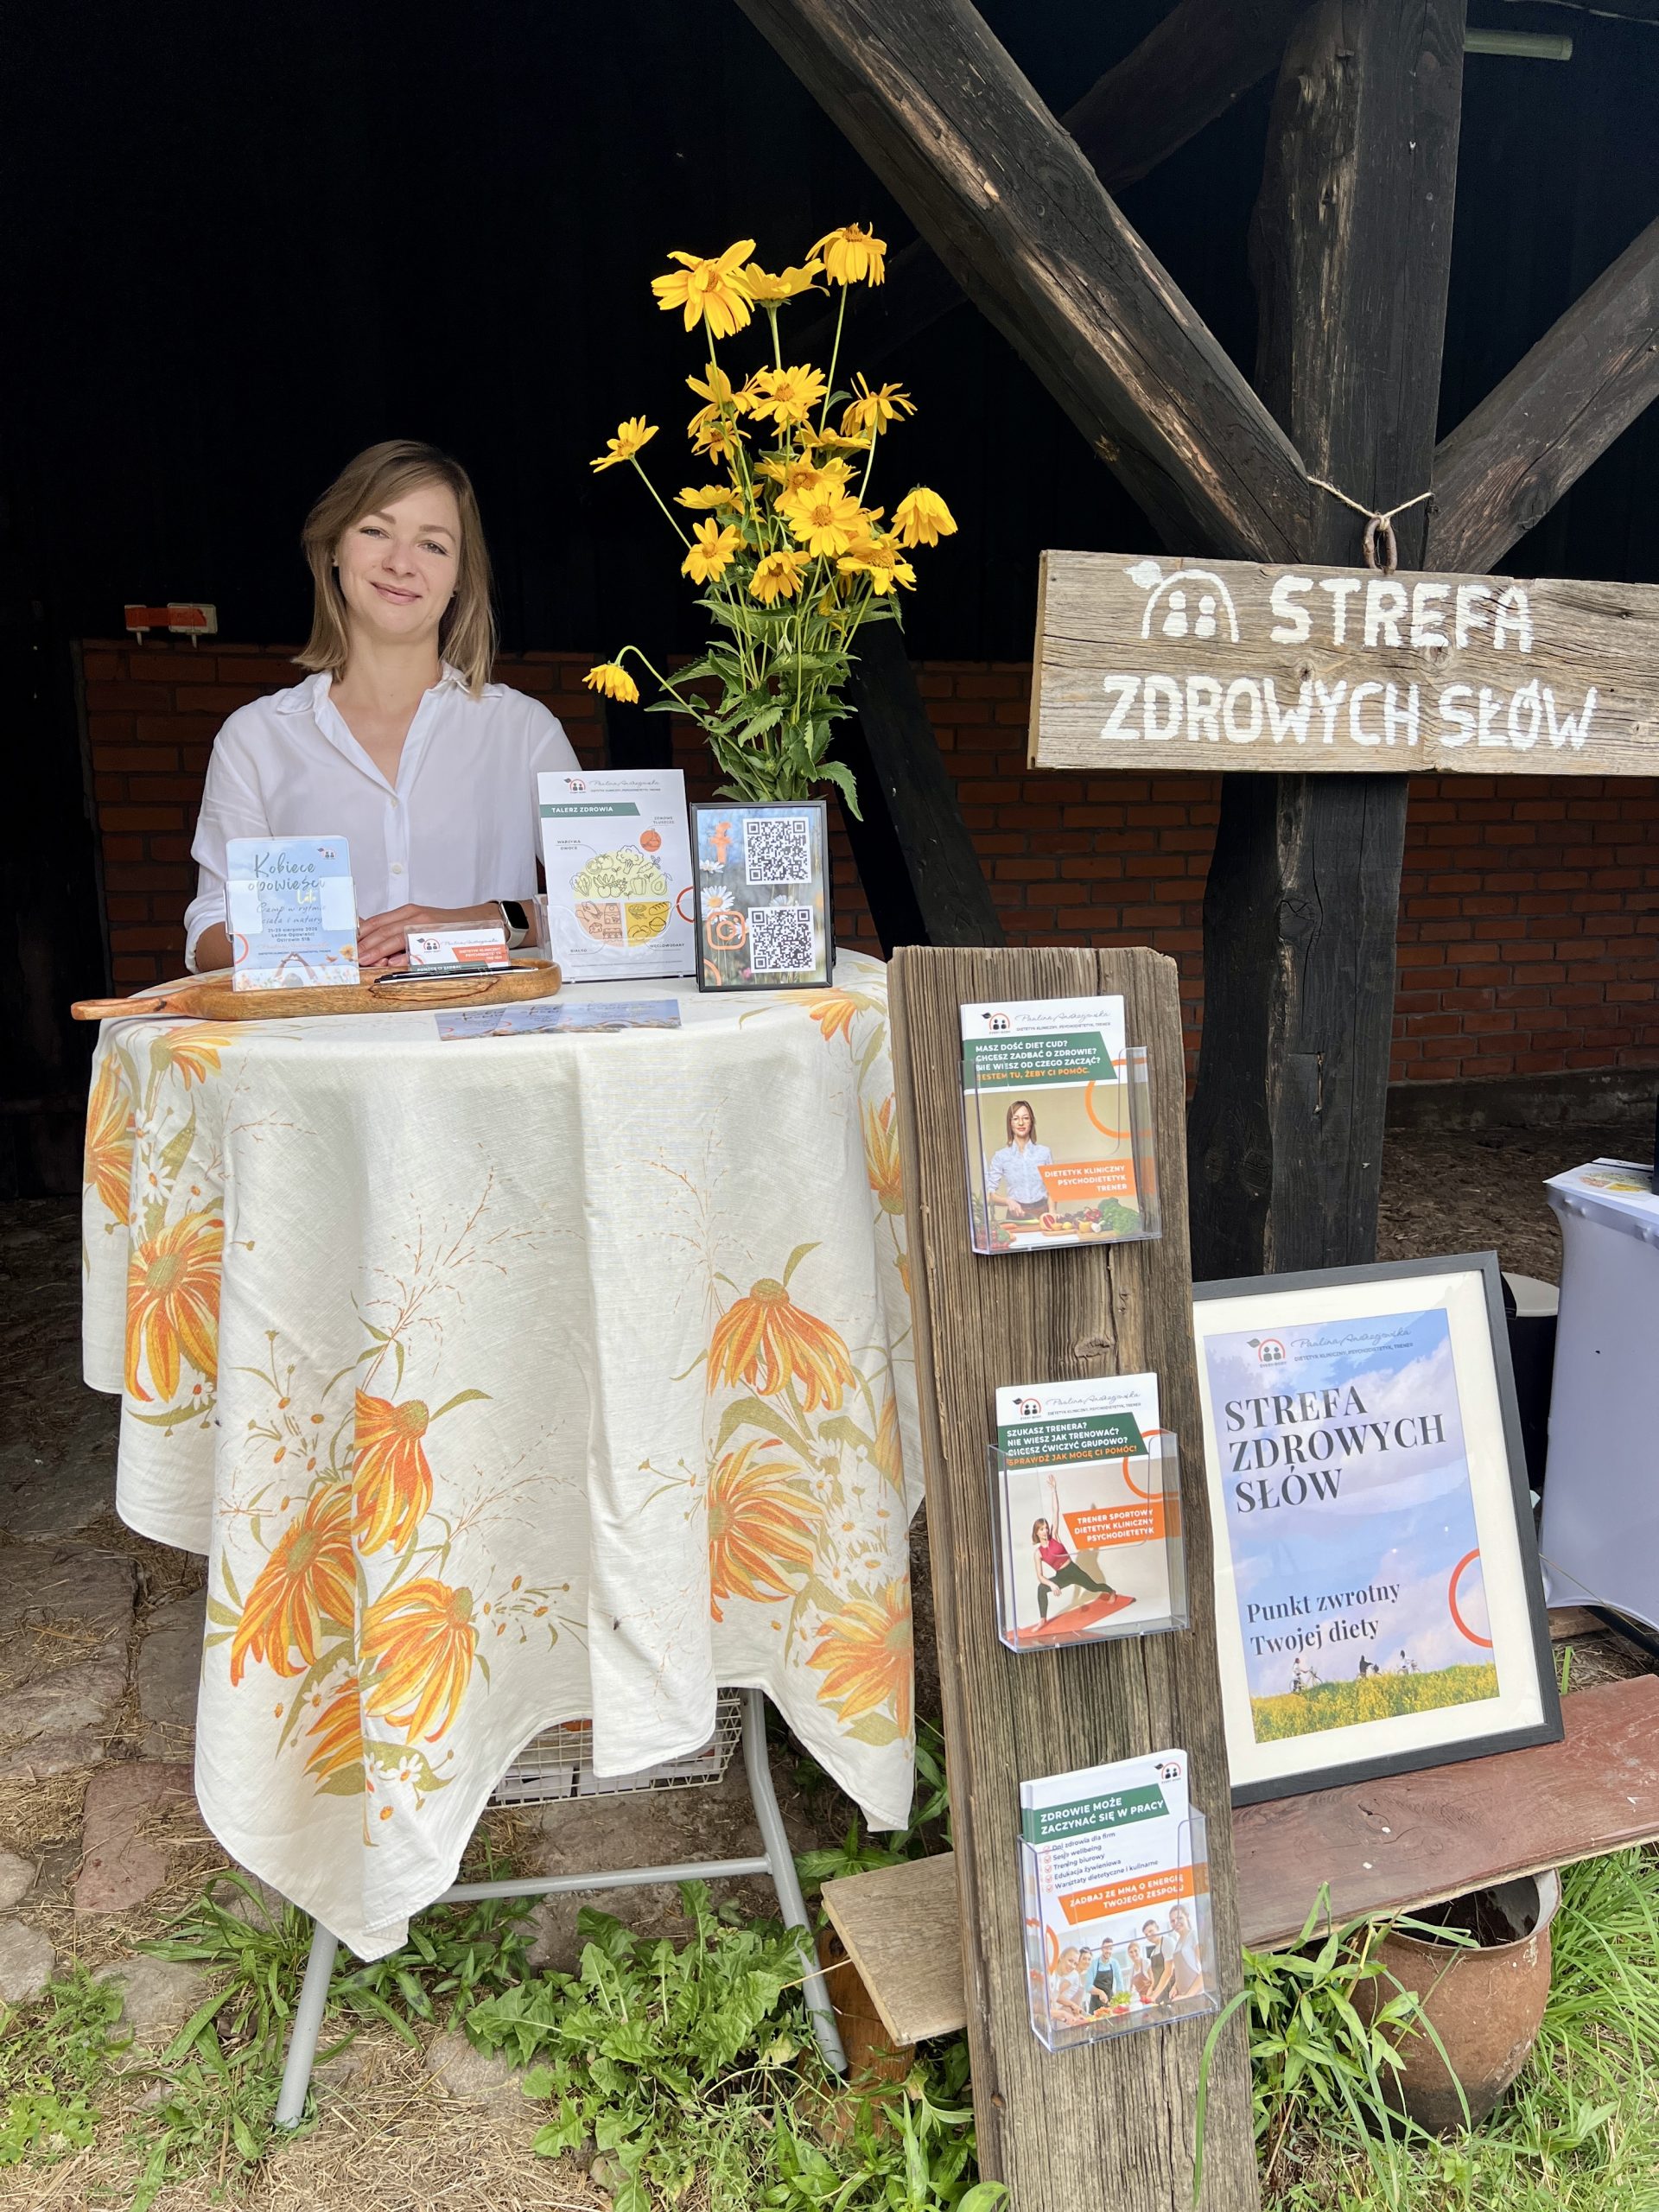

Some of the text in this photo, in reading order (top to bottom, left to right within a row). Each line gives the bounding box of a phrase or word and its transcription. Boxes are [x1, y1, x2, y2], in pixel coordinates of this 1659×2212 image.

[1269, 574, 1535, 654] STREFA
[1100, 675, 1599, 751] ZDROWYCH SŁÓW
[254, 852, 315, 878] Kobiece
[976, 1044, 999, 1052] MASZ
[1001, 1041, 1023, 1052] DOŚĆ
[976, 1052, 1008, 1062] CHCESZ
[1010, 1050, 1044, 1060] ZADBAĆ
[1054, 1048, 1097, 1057] ZDROWIE?
[976, 1071, 1007, 1081] JESTEM
[1025, 1068, 1046, 1078] ŻEBY
[1058, 1067, 1090, 1076] POMÓC.
[993, 1062, 1019, 1071] WIESZ
[1034, 1059, 1063, 1068] CZEGO
[1065, 1057, 1101, 1067] ZACZĄĆ?
[1045, 1166, 1125, 1178] DIETETYK KLINICZNY
[1058, 1174, 1126, 1186] PSYCHODIETETYK
[1096, 1184, 1127, 1192] TRENER
[1224, 1385, 1367, 1432] STREFA
[1007, 1422, 1087, 1437] SZUKASZ TRENERA?
[1024, 1435, 1049, 1445] WIESZ
[1051, 1433, 1067, 1442] JAK
[1069, 1427, 1119, 1440] TRENOWAĆ?
[1007, 1437, 1128, 1457] CHCESZ ĆWICZYĆ GRUPOWO?
[1229, 1413, 1446, 1473] ZDROWYCH
[1007, 1453, 1050, 1466] SPRAWDŹ
[1069, 1450, 1093, 1460] MOGĘ
[1105, 1446, 1137, 1455] POMÓC!
[1236, 1465, 1343, 1514] SŁÓW
[1074, 1518, 1154, 1535] DIETETYK KLINICZNY
[1077, 1509, 1154, 1524] TRENER SPORTOWY
[1087, 1527, 1154, 1542] PSYCHODIETETYK
[1247, 1583, 1401, 1624] Punkt zwrotny
[1250, 1618, 1380, 1656] Twojej diety
[1040, 1796, 1122, 1823] ZDROWIE MOŻE
[1041, 1800, 1164, 1835] ZACZYNAĆ SIĘ W PRACY
[1065, 1838, 1090, 1848] zdrowia
[1071, 1845, 1103, 1856] wellbeing
[1053, 1853, 1105, 1871] Trening biurowy
[1054, 1859, 1122, 1881] Edukacja żywieniowa
[1054, 1877, 1087, 1890] Warsztaty
[1087, 1868, 1124, 1881] dietetyczne
[1128, 1859, 1159, 1872] kulinarne
[1070, 1892, 1103, 1908] ZADBAJ
[1105, 1890, 1116, 1899] ZE
[1117, 1885, 1137, 1896] MNĄ
[1147, 1874, 1184, 1888] ENERGIĘ
[1103, 1884, 1184, 1909] TWOJEGO ZESPOŁU
